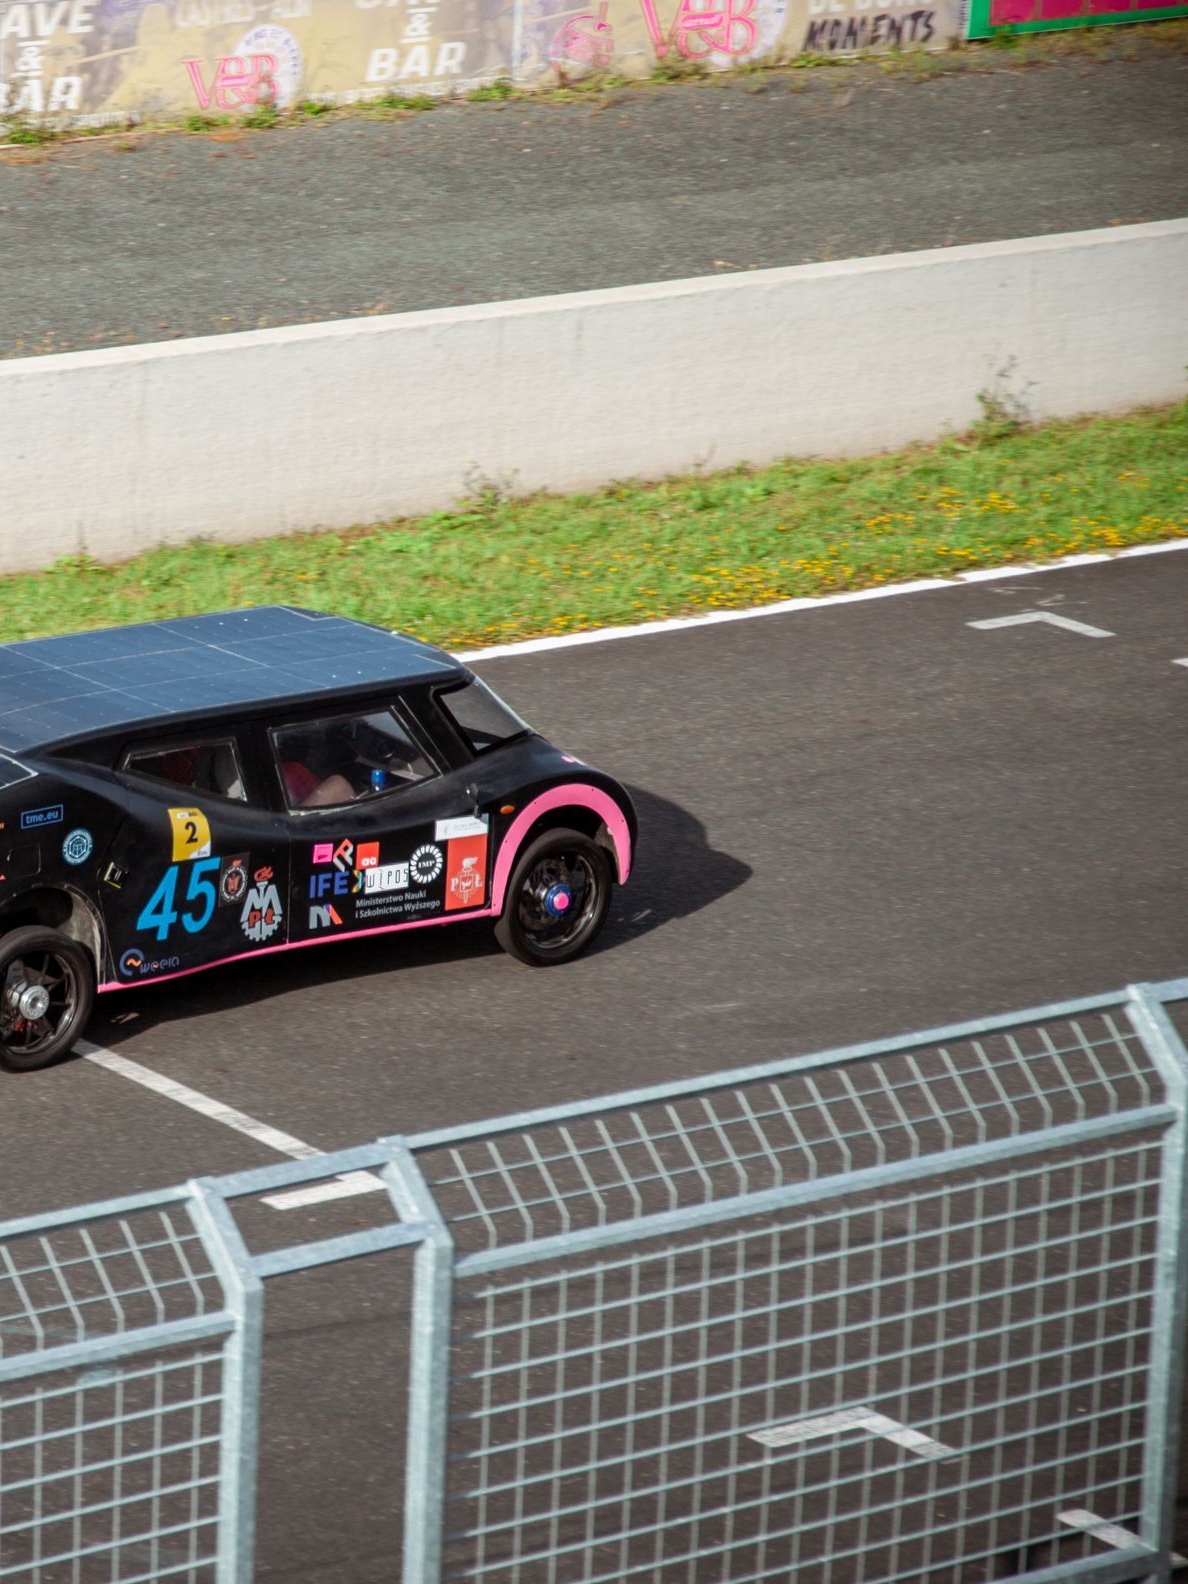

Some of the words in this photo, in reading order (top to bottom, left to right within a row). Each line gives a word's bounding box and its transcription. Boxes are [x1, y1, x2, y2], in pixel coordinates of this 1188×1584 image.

[365, 42, 468, 82] BAR
[25, 809, 60, 825] tme.eu
[184, 821, 199, 845] 2
[418, 860, 436, 869] IMP
[309, 870, 350, 899] IFE
[136, 856, 222, 942] 45
[355, 895, 403, 908] Ministerstwo
[404, 890, 427, 903] Nauki
[359, 904, 403, 919] Szkolnictwa
